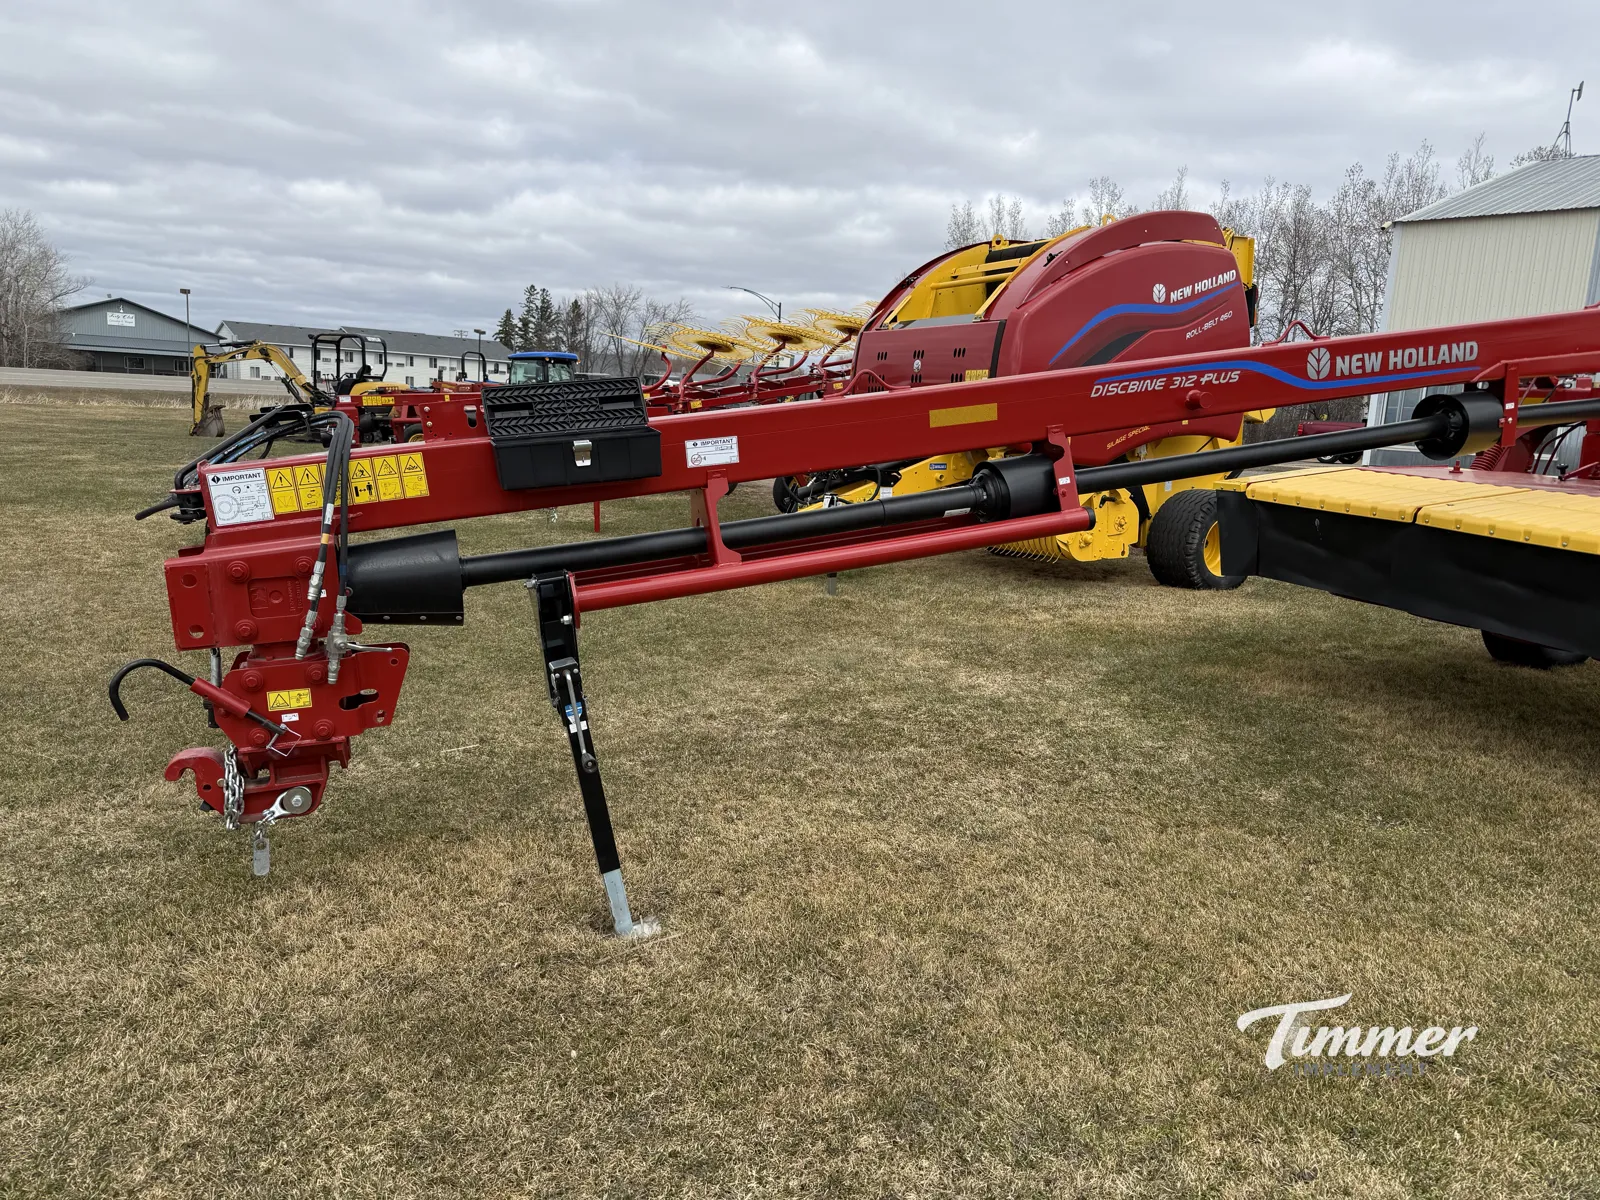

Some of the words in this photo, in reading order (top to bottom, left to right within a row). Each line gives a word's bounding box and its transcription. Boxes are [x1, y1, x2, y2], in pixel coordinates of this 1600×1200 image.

[1170, 285, 1193, 303] NEW
[1194, 269, 1237, 294] HOLLAND
[1185, 317, 1219, 340] ROLL-BELT
[1219, 310, 1233, 322] 460
[1335, 351, 1383, 377] NEW
[1388, 340, 1479, 371] HOLLAND
[1090, 377, 1167, 398] DISCBINE
[1169, 375, 1197, 389] 312
[701, 438, 733, 446] IMPORTANT
[1106, 433, 1127, 450] SILAGE
[221, 472, 261, 482] IMPORTANT
